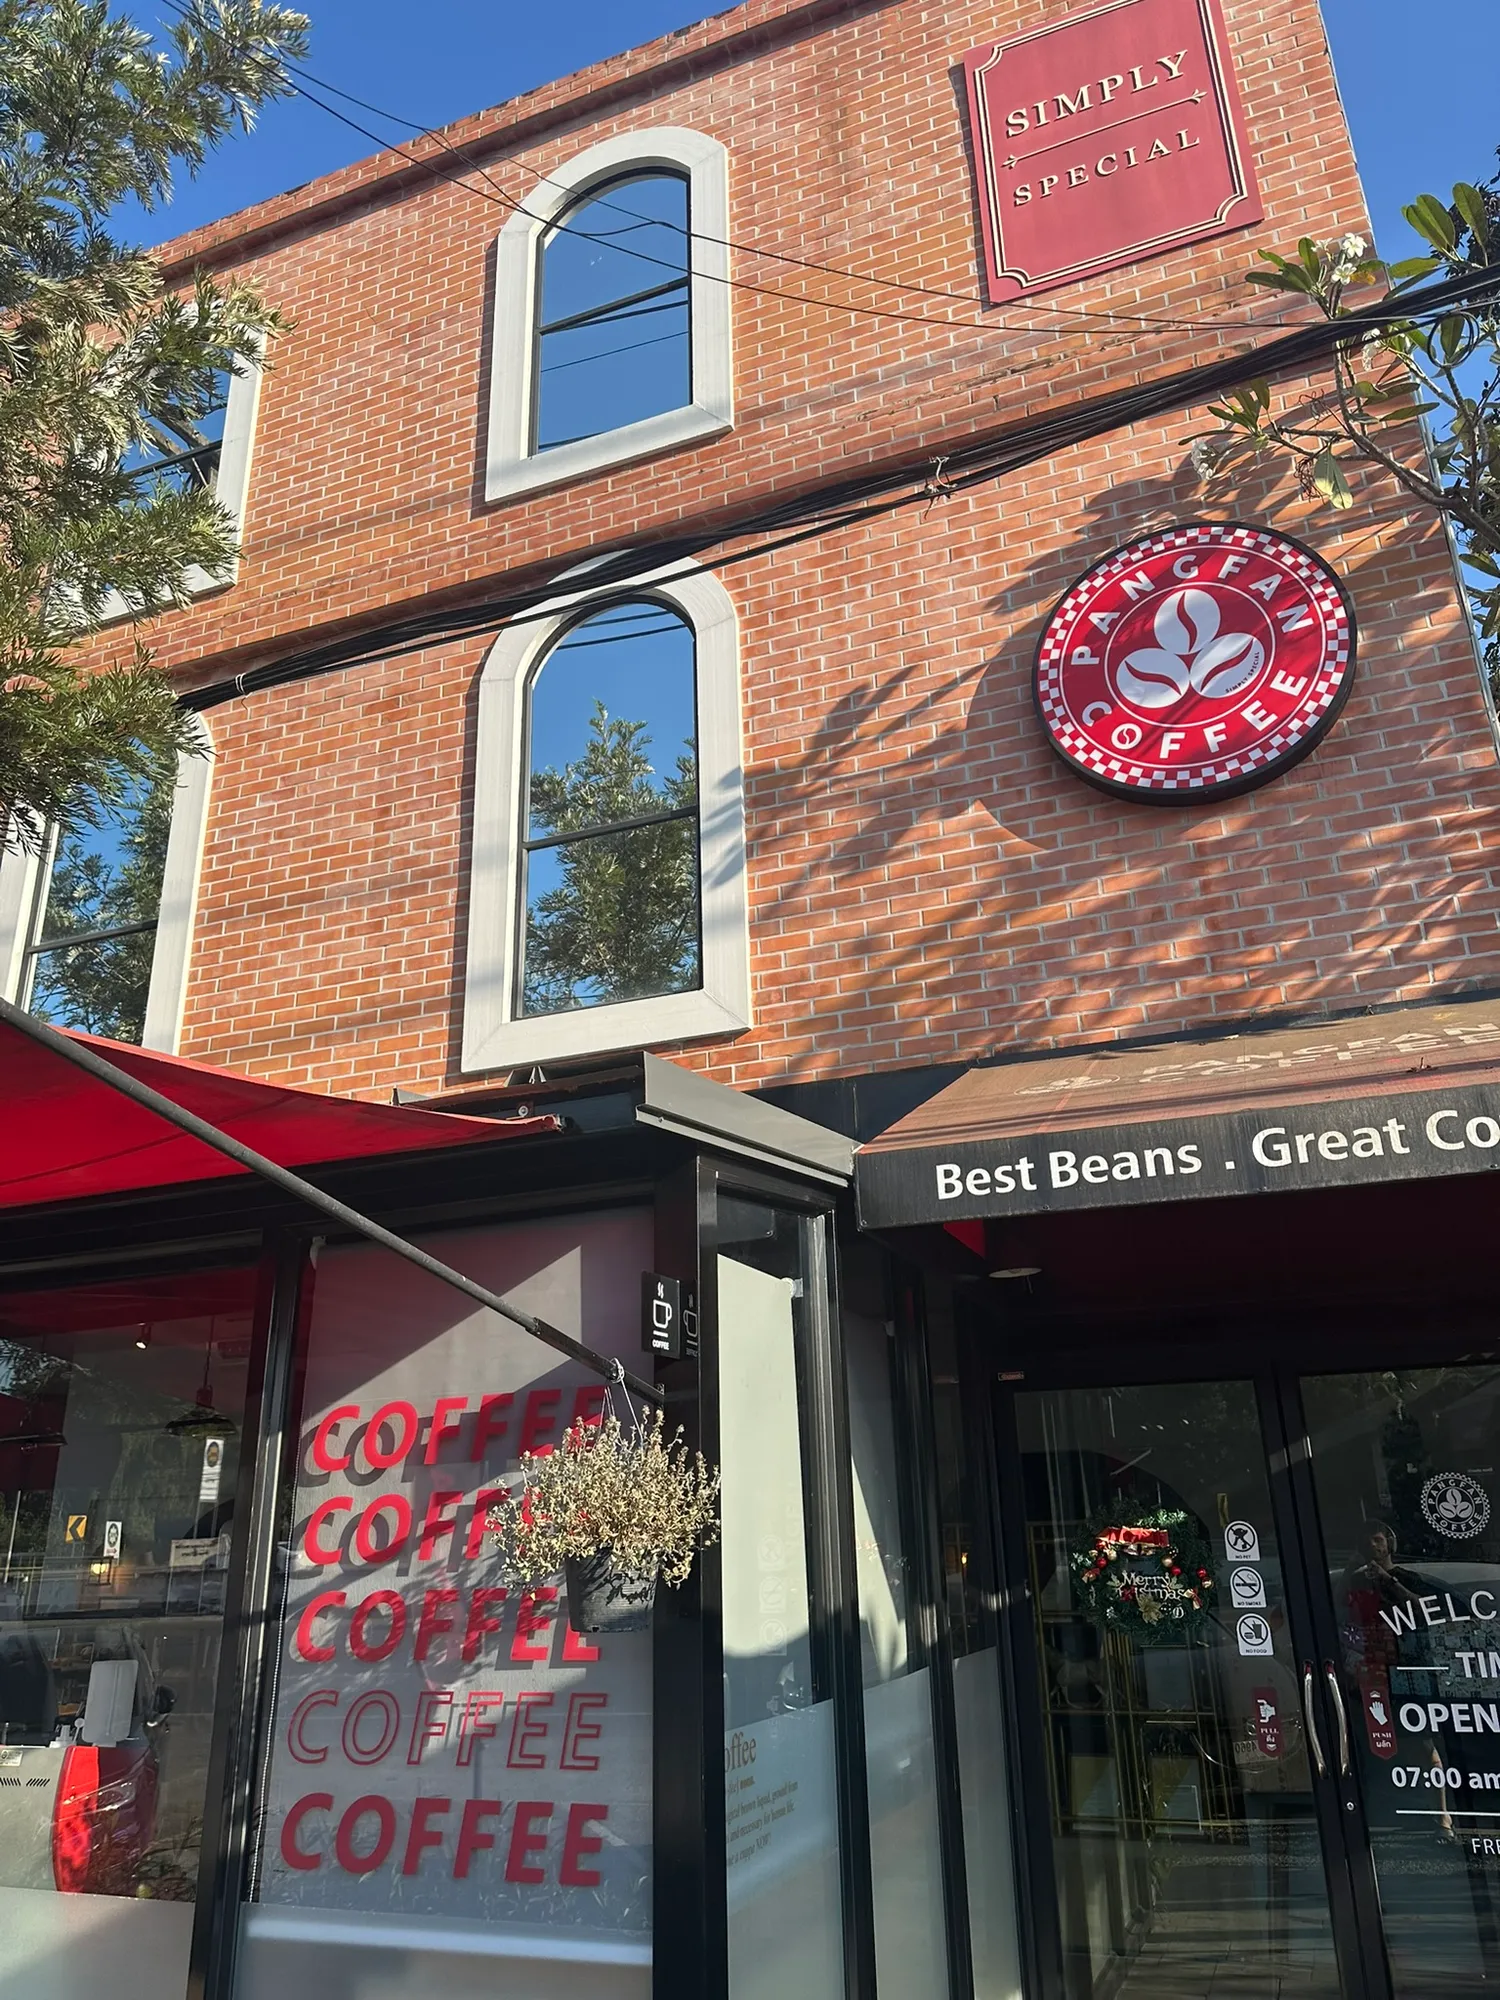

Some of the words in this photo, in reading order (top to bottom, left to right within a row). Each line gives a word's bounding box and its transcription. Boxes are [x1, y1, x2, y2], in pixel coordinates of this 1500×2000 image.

[1006, 49, 1188, 137] SIMPLY
[1014, 128, 1200, 206] SPECIAL
[1071, 554, 1314, 665] PANGFAN
[1225, 677, 1248, 693] SIMPLY
[1248, 652, 1260, 676] SPECIAL
[1081, 670, 1308, 759] COFFEE
[935, 1155, 1039, 1200] Best
[1048, 1143, 1203, 1190] Beans
[1251, 1117, 1411, 1169] Great
[652, 1339, 670, 1351] COFFEE
[1428, 1479, 1483, 1505] PANGFAN
[1431, 1513, 1484, 1532] COFFEE
[303, 1488, 590, 1567] COFF
[1121, 1570, 1171, 1589] Merry
[1379, 1590, 1497, 1636] WELC
[287, 1689, 608, 1771] COFFEE
[1399, 1703, 1500, 1733] OPEN
[1391, 1767, 1462, 1789] 07:00
[1468, 1772, 1500, 1789] am
[279, 1793, 608, 1887] COFFEE
